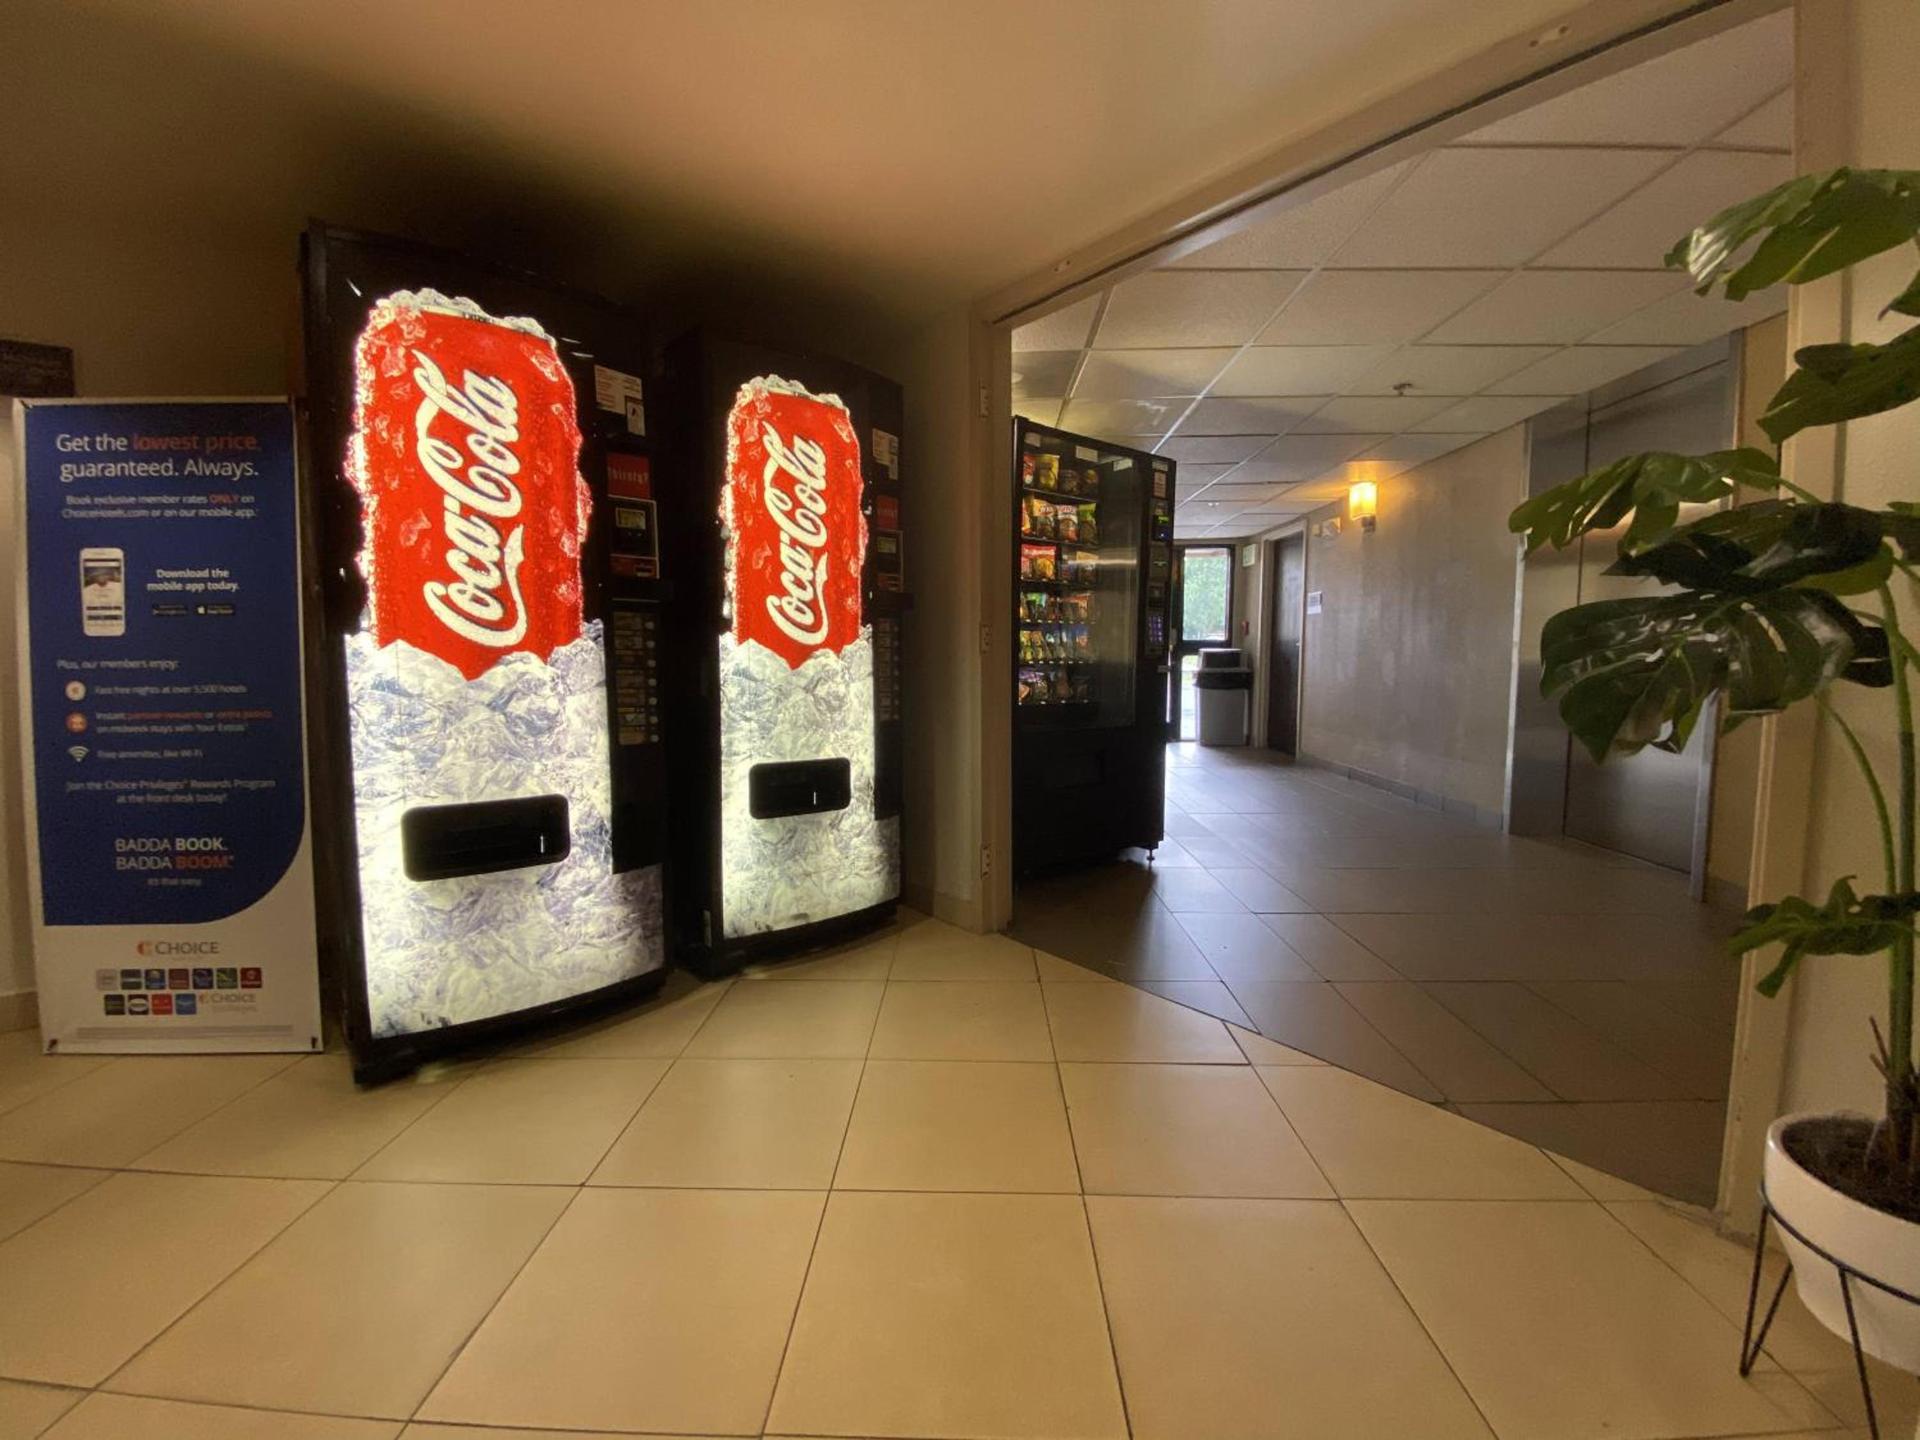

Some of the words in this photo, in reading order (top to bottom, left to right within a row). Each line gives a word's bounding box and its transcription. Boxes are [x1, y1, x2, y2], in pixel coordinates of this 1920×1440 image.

[56, 434, 90, 452] Get
[95, 434, 128, 452] the
[133, 434, 199, 451] lowest
[60, 458, 179, 482] guaranteed.
[184, 458, 259, 481] Always.
[138, 495, 180, 504] member
[182, 495, 208, 504] rates
[241, 496, 255, 504] on
[411, 349, 528, 647] Coca-Cola
[163, 509, 177, 517] on
[179, 509, 196, 517] our
[198, 507, 233, 517] mobile
[763, 420, 828, 645] Coca-Cola
[156, 567, 209, 578] Download
[211, 568, 230, 578] the
[147, 580, 184, 591] mobile
[185, 582, 205, 593] app
[207, 580, 241, 593] today.
[100, 659, 147, 669] members
[115, 839, 171, 852] BADDA
[175, 838, 228, 851] BOOK.
[116, 856, 173, 870] BADDA
[155, 941, 219, 955] CHOICE
